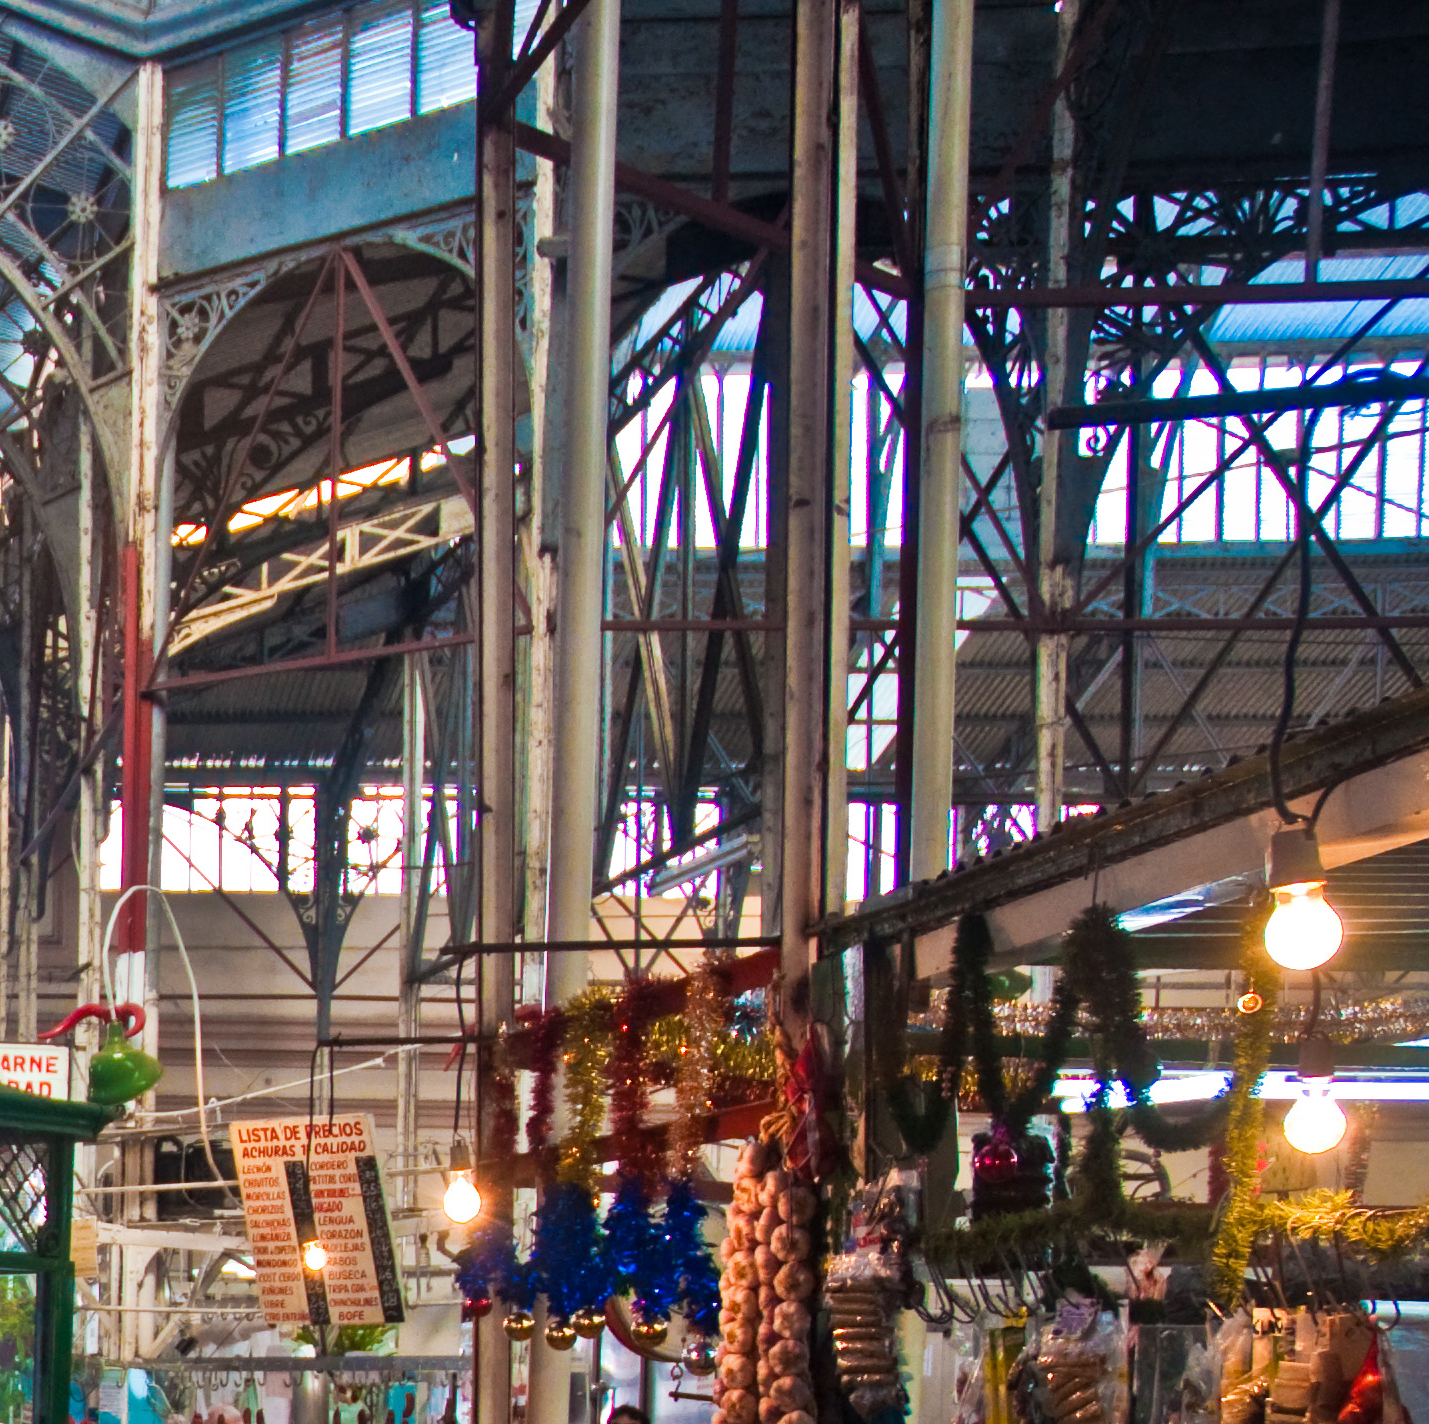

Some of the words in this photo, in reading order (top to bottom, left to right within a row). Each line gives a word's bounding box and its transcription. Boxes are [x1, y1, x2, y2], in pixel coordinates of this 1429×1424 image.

[238, 1127, 281, 1144] LISTA
[283, 1124, 301, 1142] DE
[305, 1121, 363, 1141] PRECIOS
[242, 1143, 296, 1159] ACHURAS
[314, 1140, 366, 1156] CALIDAD
[318, 1215, 355, 1226] LENGUA
[338, 1311, 365, 1321] BOFE
